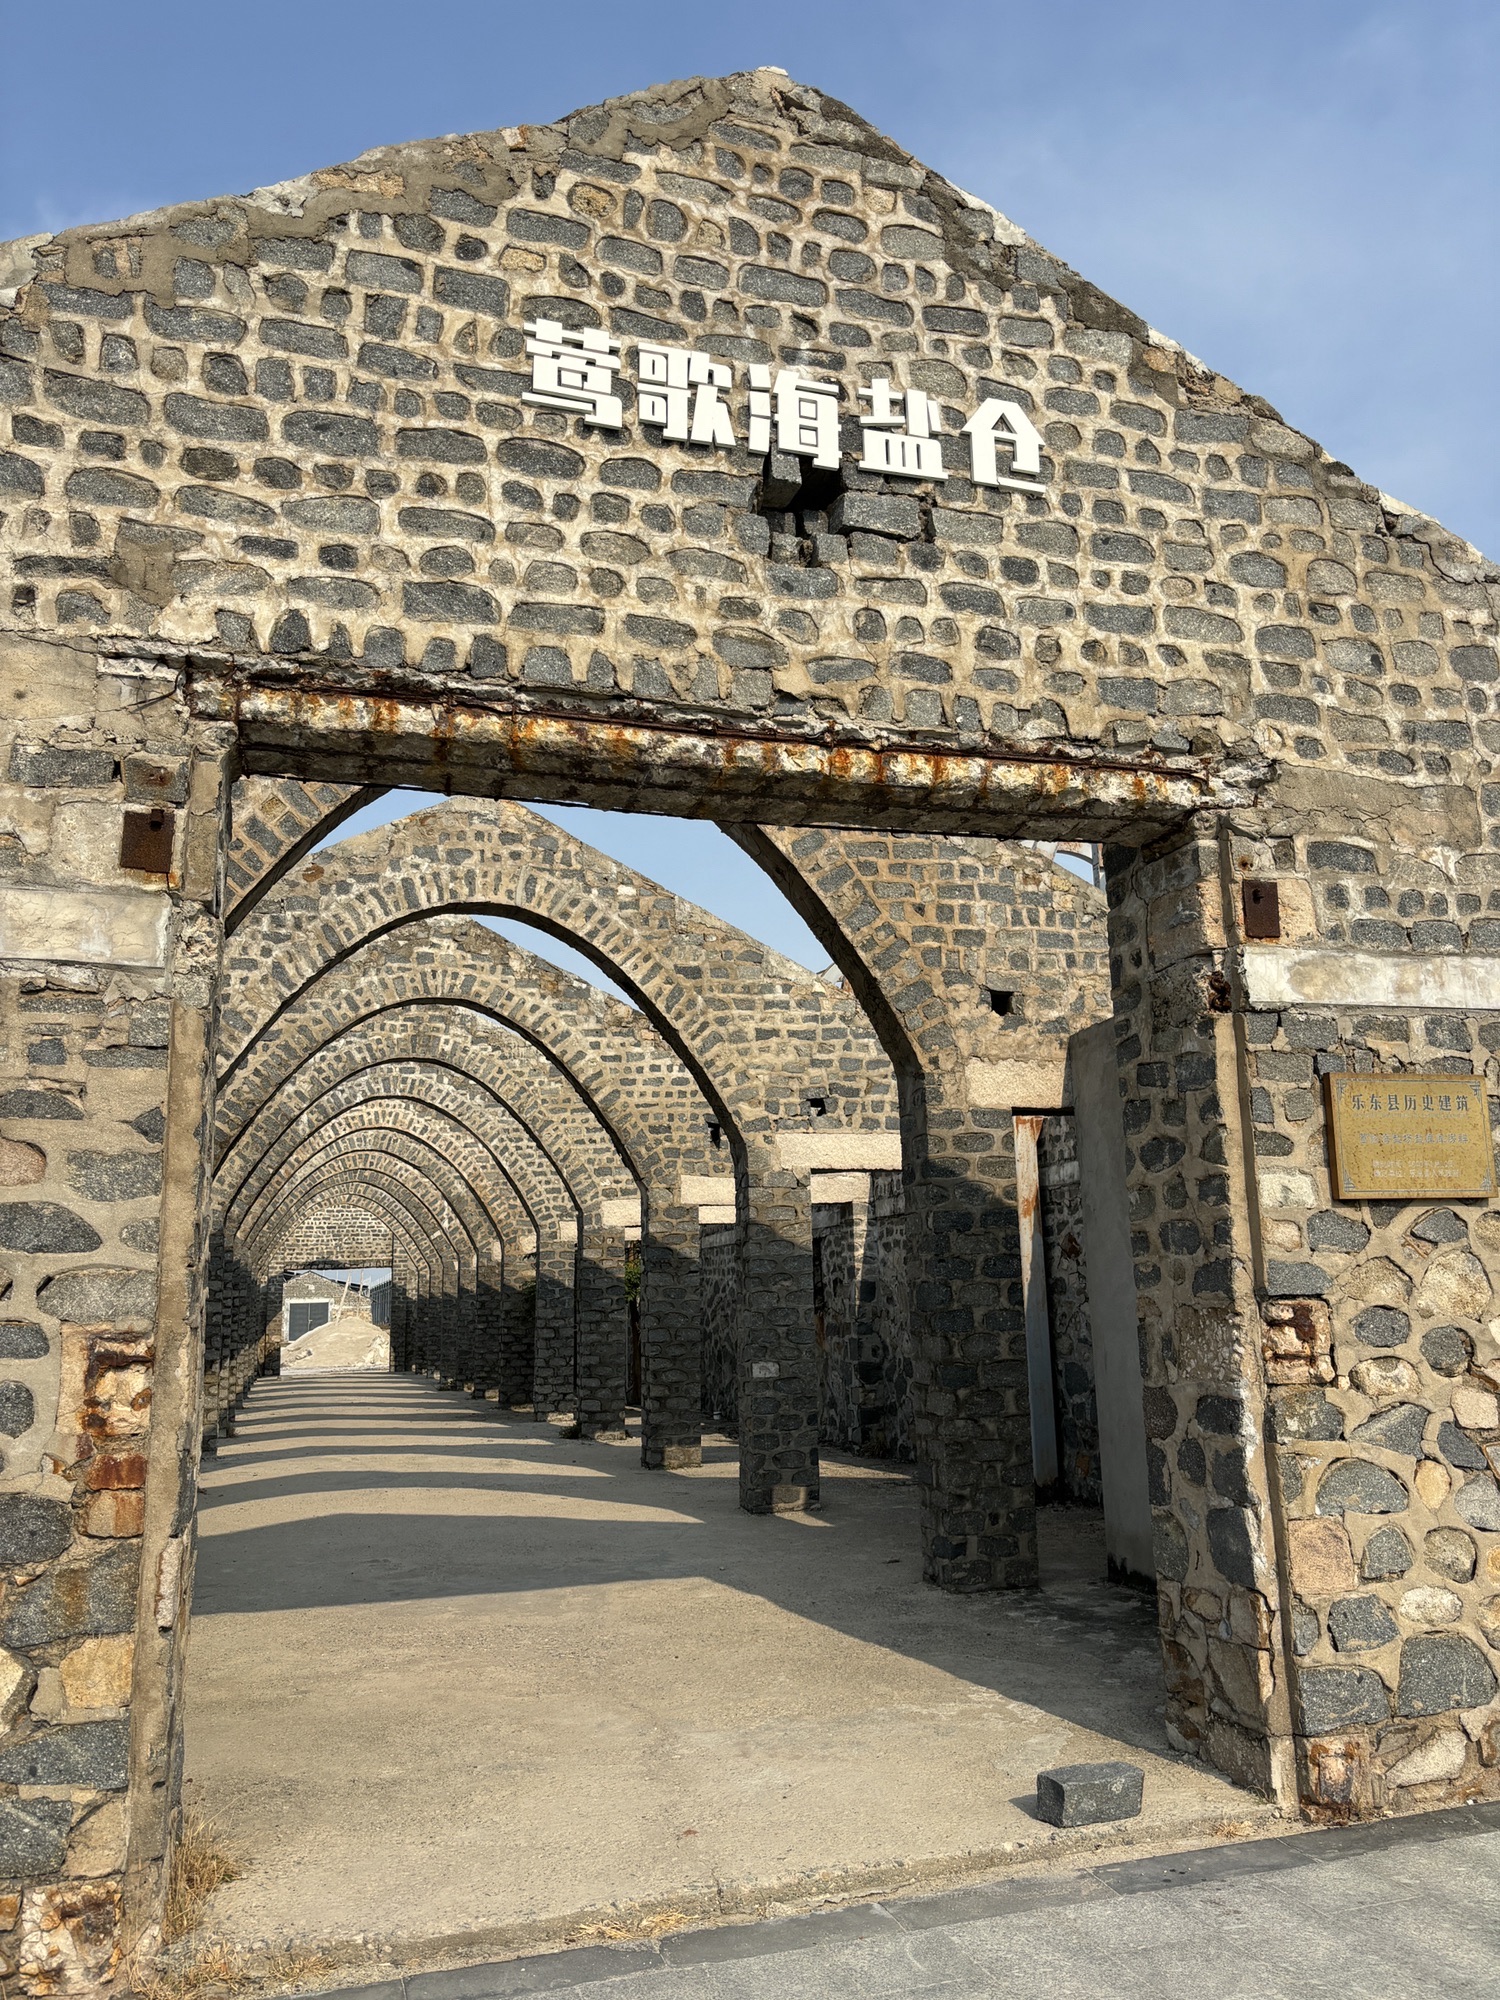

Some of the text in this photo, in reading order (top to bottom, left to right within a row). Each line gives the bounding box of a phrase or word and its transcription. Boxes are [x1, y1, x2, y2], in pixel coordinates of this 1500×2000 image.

[522, 318, 1046, 495] 莺歌海盐仓
[1352, 1094, 1469, 1112] 乐东县历史建筑
